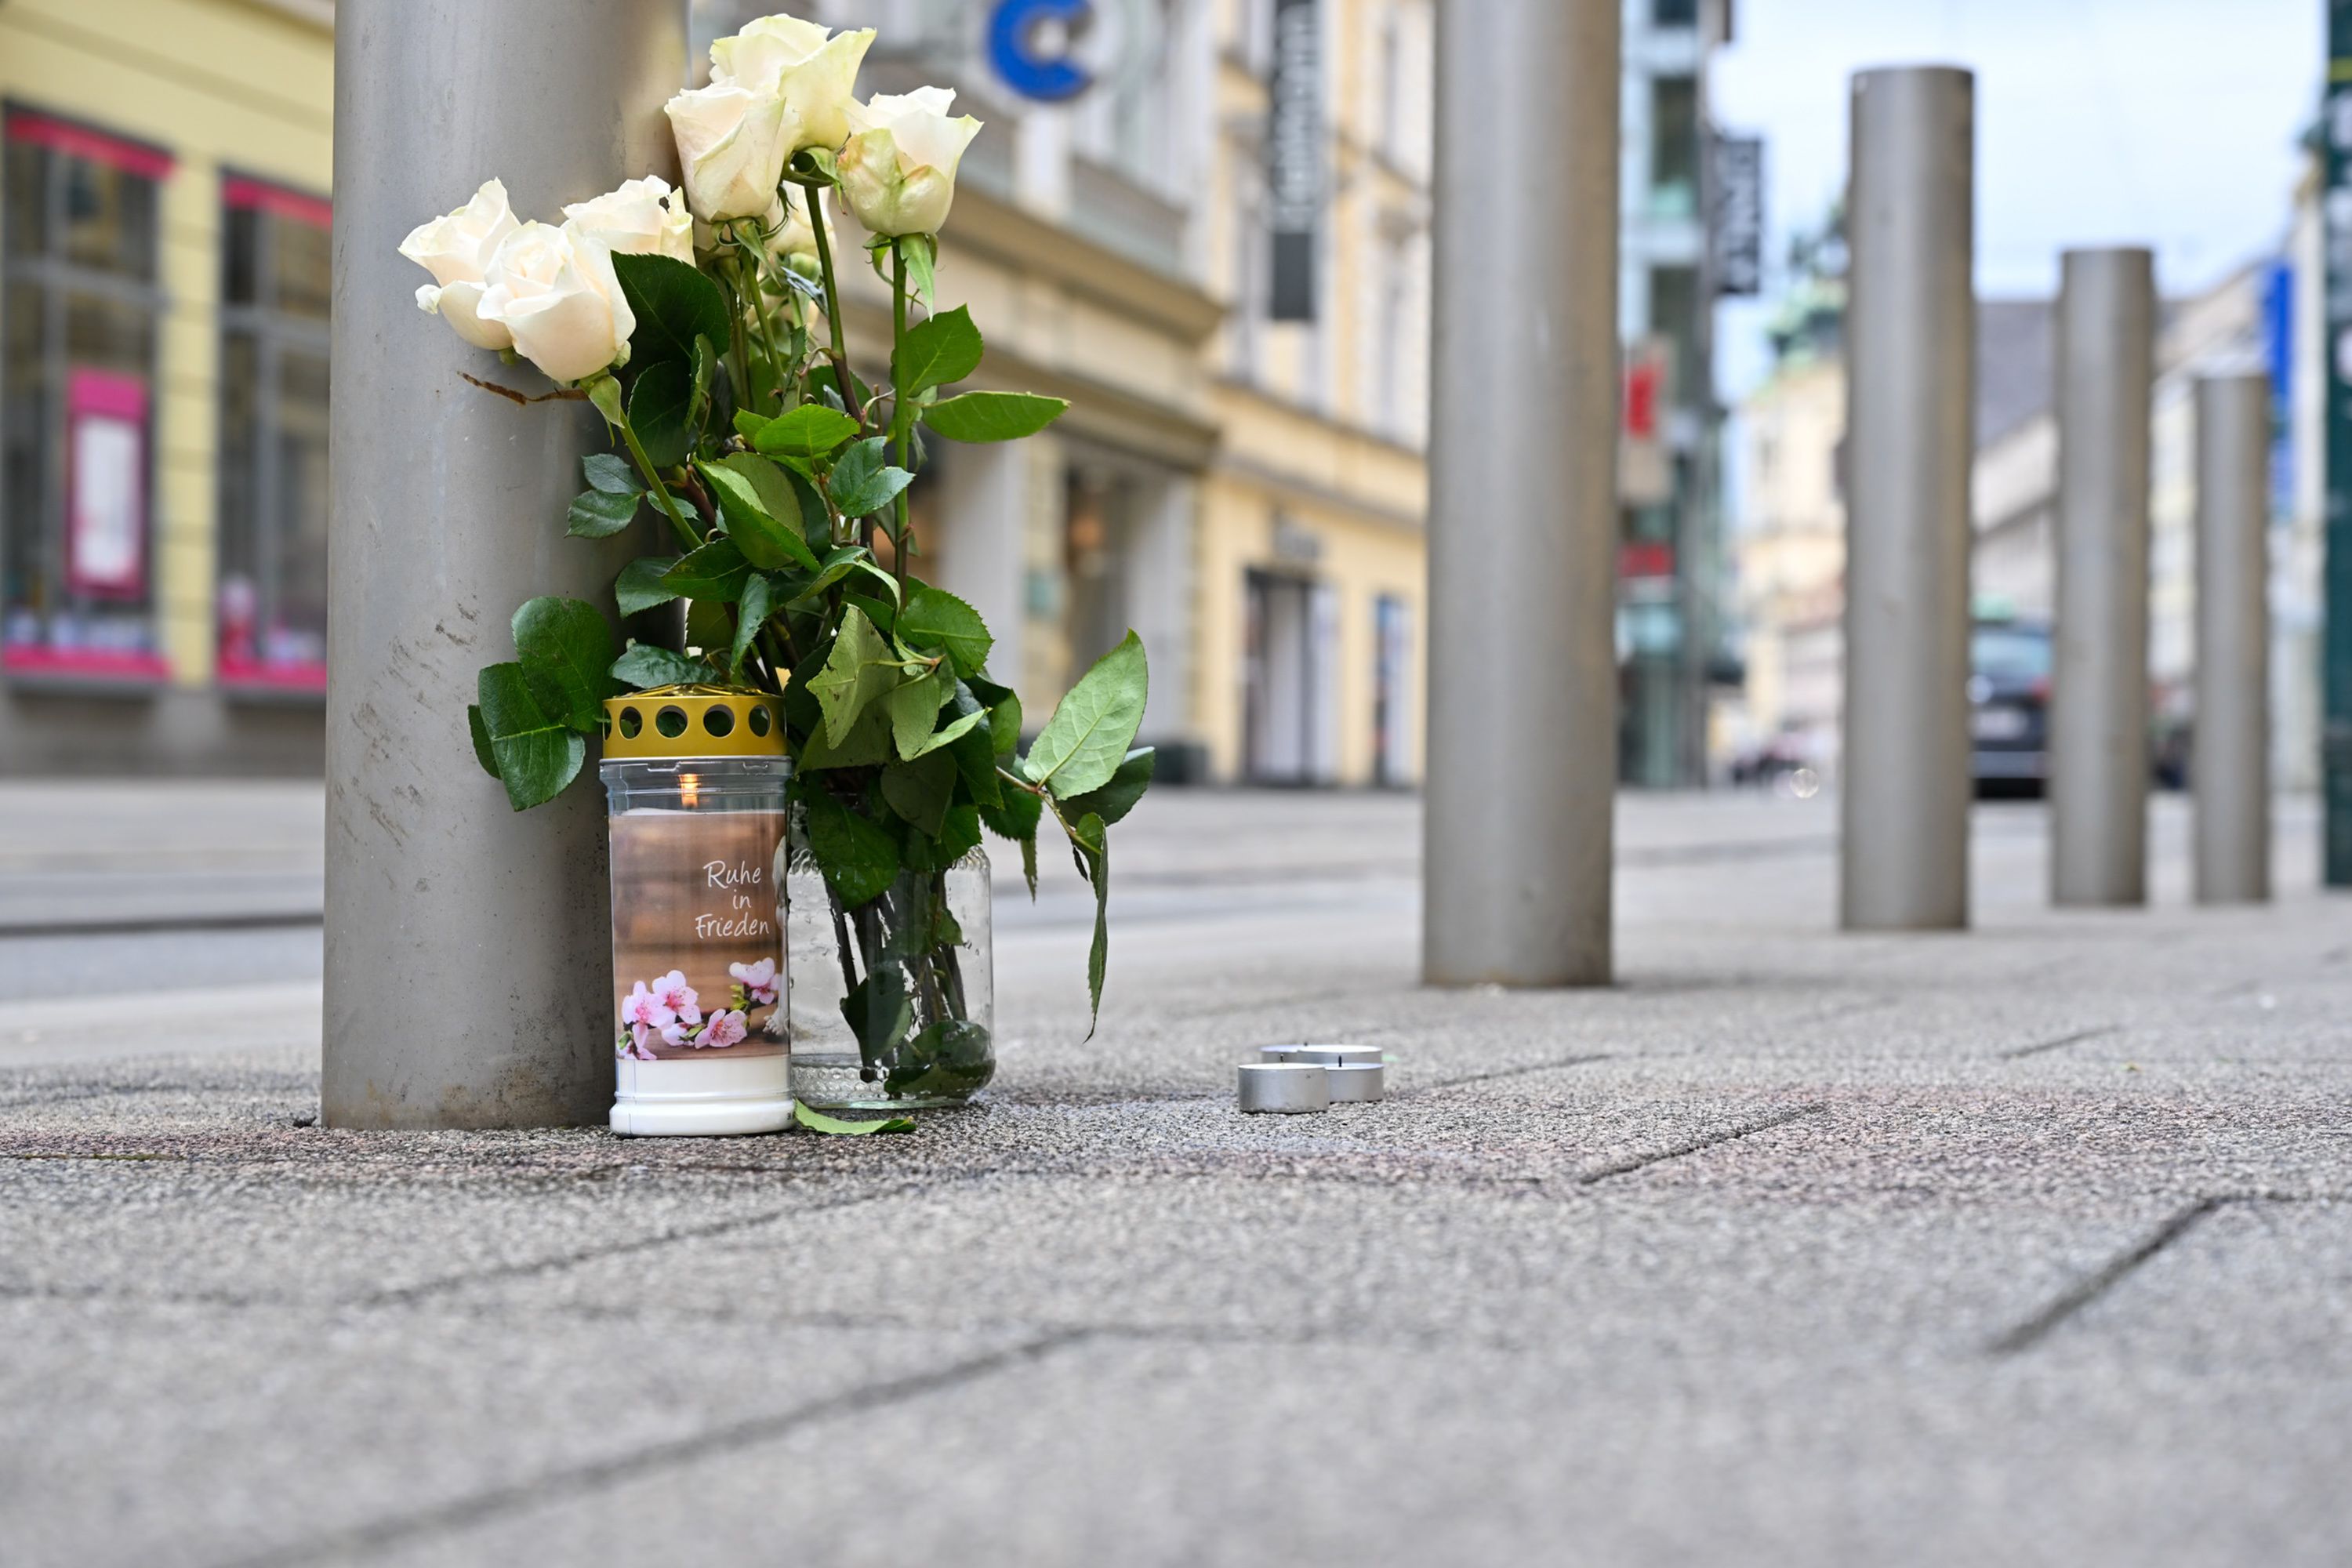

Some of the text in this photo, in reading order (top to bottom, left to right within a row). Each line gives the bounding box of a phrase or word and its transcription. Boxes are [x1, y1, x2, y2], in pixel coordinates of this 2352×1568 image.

[702, 860, 761, 889] Ruhe
[732, 888, 753, 910] in
[695, 911, 770, 939] Frieden
